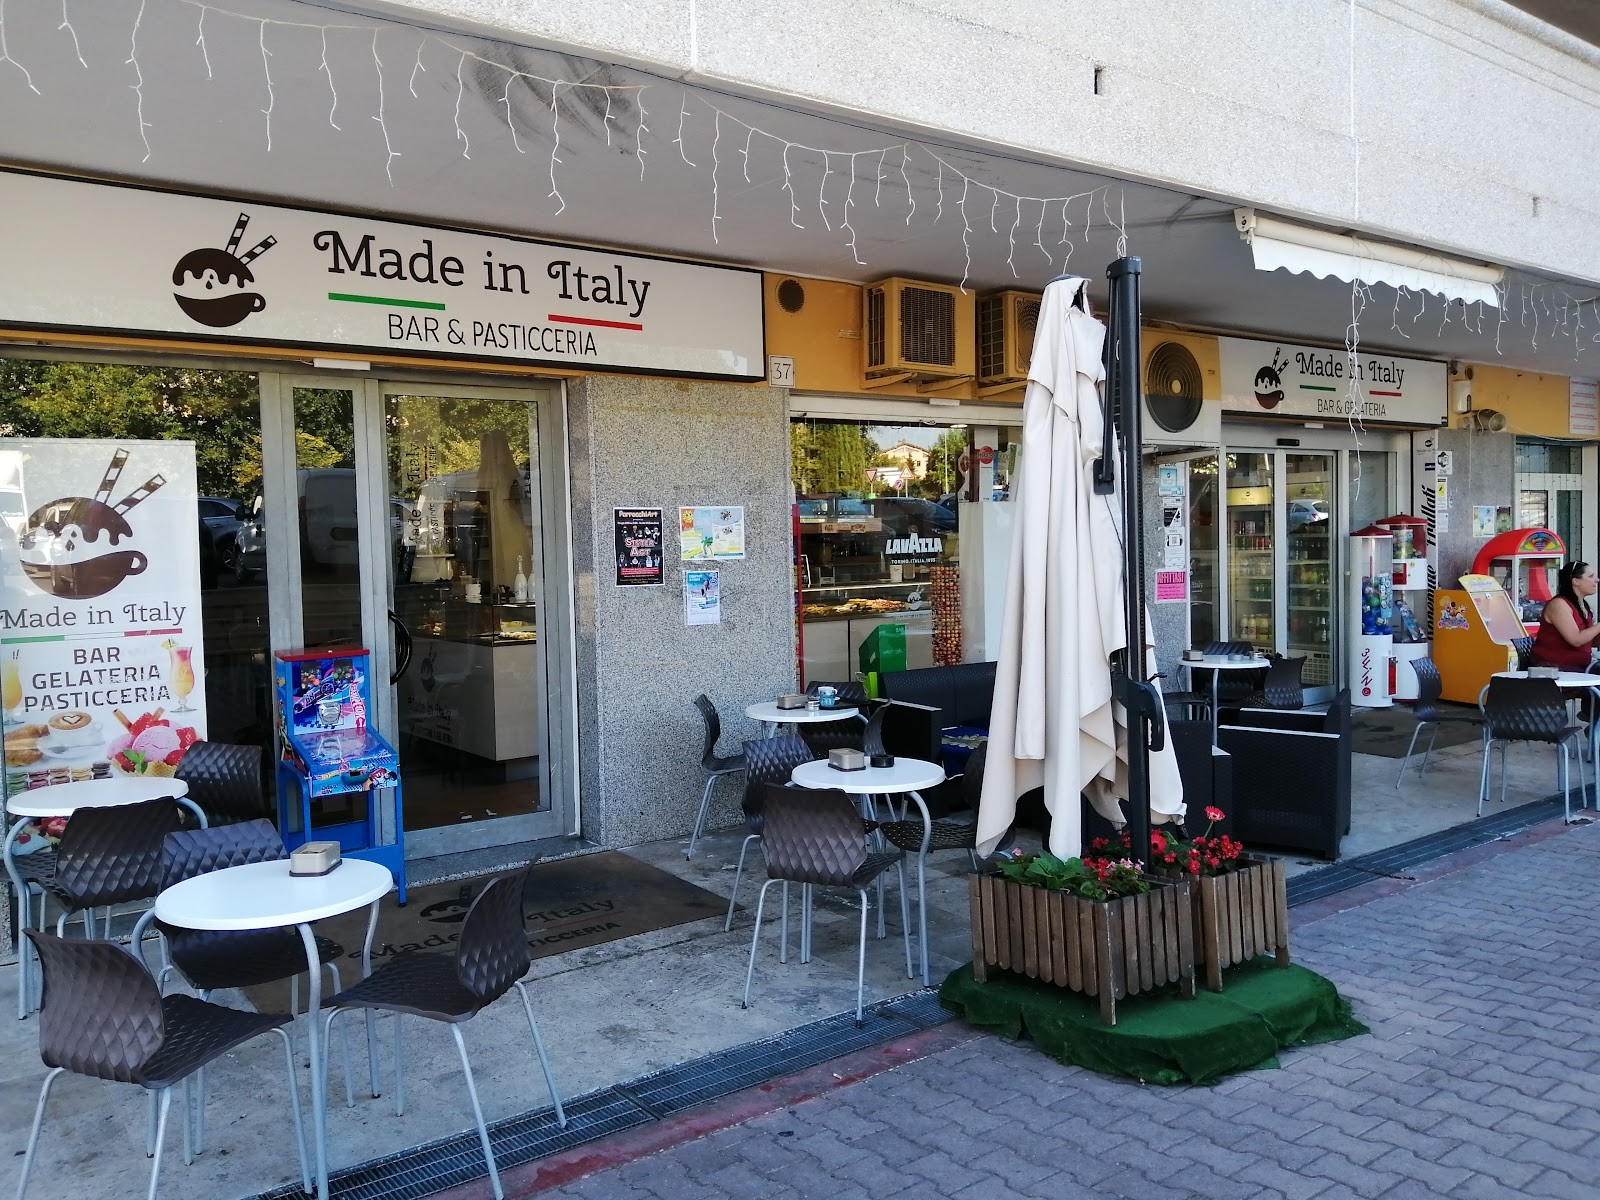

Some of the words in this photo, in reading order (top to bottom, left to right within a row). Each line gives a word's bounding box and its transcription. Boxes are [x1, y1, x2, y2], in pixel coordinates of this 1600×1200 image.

[313, 230, 465, 287] Made
[483, 250, 530, 294] in
[547, 260, 651, 318] Italy
[388, 313, 440, 344] BAR
[447, 318, 466, 345] &
[473, 321, 598, 356] PASTICCERIA
[773, 362, 792, 380] 37
[1295, 352, 1343, 378] Made
[1368, 360, 1405, 390] Italy
[1317, 398, 1335, 414] BAR
[1336, 400, 1343, 415] &
[885, 532, 943, 555] LAVAZZA
[0, 605, 77, 630] Made
[87, 605, 114, 625] in
[123, 601, 187, 627] Italy
[73, 646, 121, 665] BAR
[32, 664, 161, 690] GELATERIA
[24, 685, 171, 712] PASTICCERIA
[526, 899, 615, 923] Italy
[527, 922, 622, 948] TICCERIA
